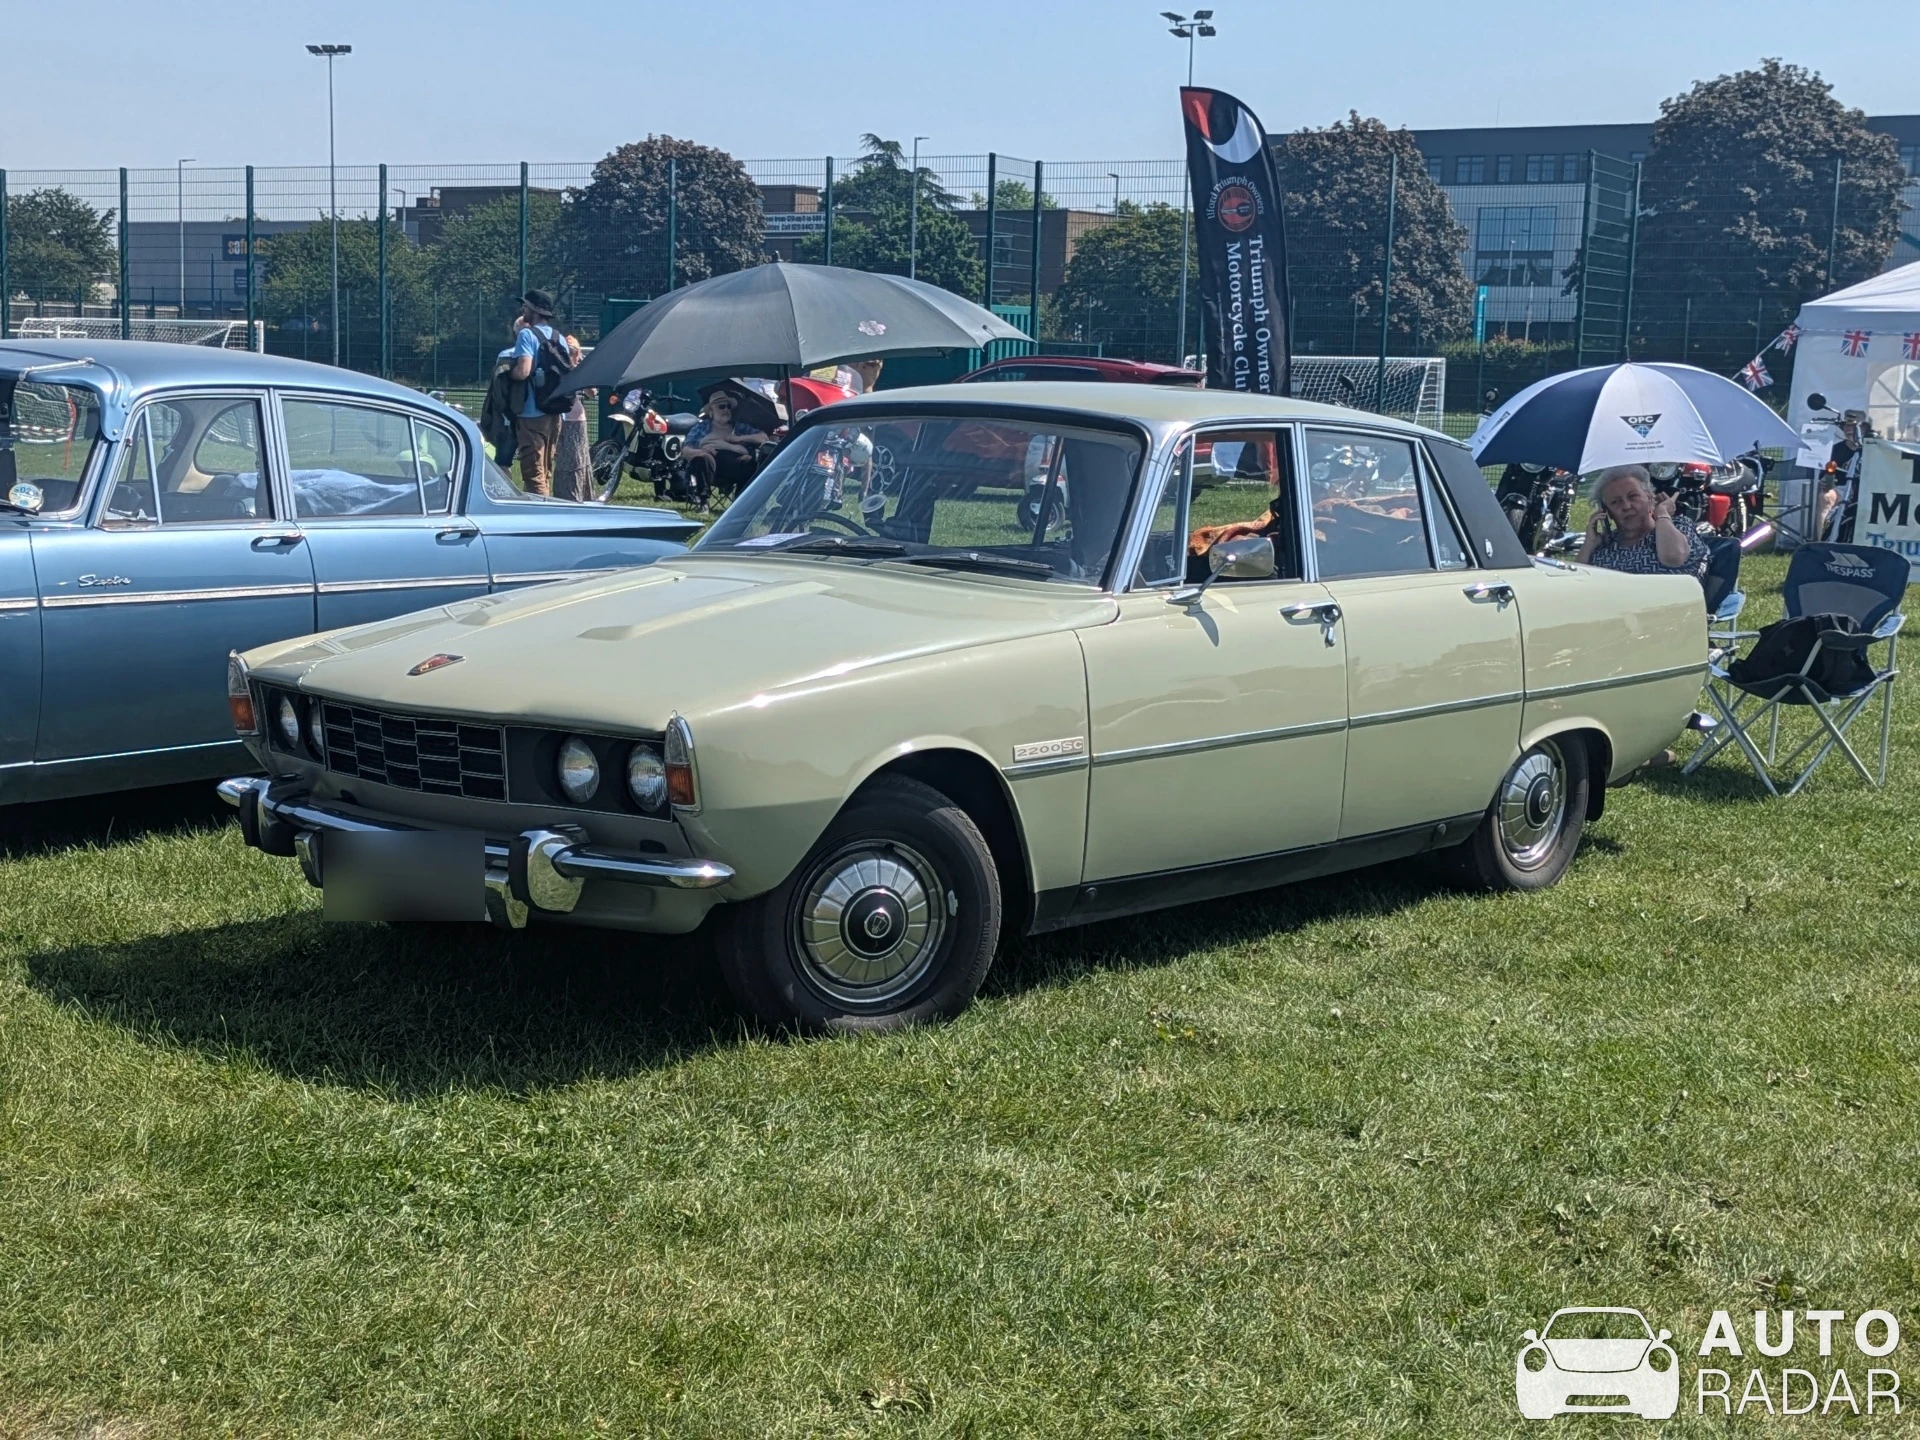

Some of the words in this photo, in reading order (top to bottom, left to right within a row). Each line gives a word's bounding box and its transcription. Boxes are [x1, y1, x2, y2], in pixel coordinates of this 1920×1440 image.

[1206, 191, 1219, 220] Ilford
[1213, 176, 1248, 193] Triumph
[1247, 182, 1264, 215] Owners
[1226, 241, 1248, 352] Motorcycle
[1248, 234, 1270, 323] Triumph
[1234, 356, 1251, 393] Clu
[1628, 416, 1654, 424] OPC
[1867, 492, 1920, 527] M
[78, 574, 132, 588] Sceptre
[1823, 561, 1874, 578] TRESPASS
